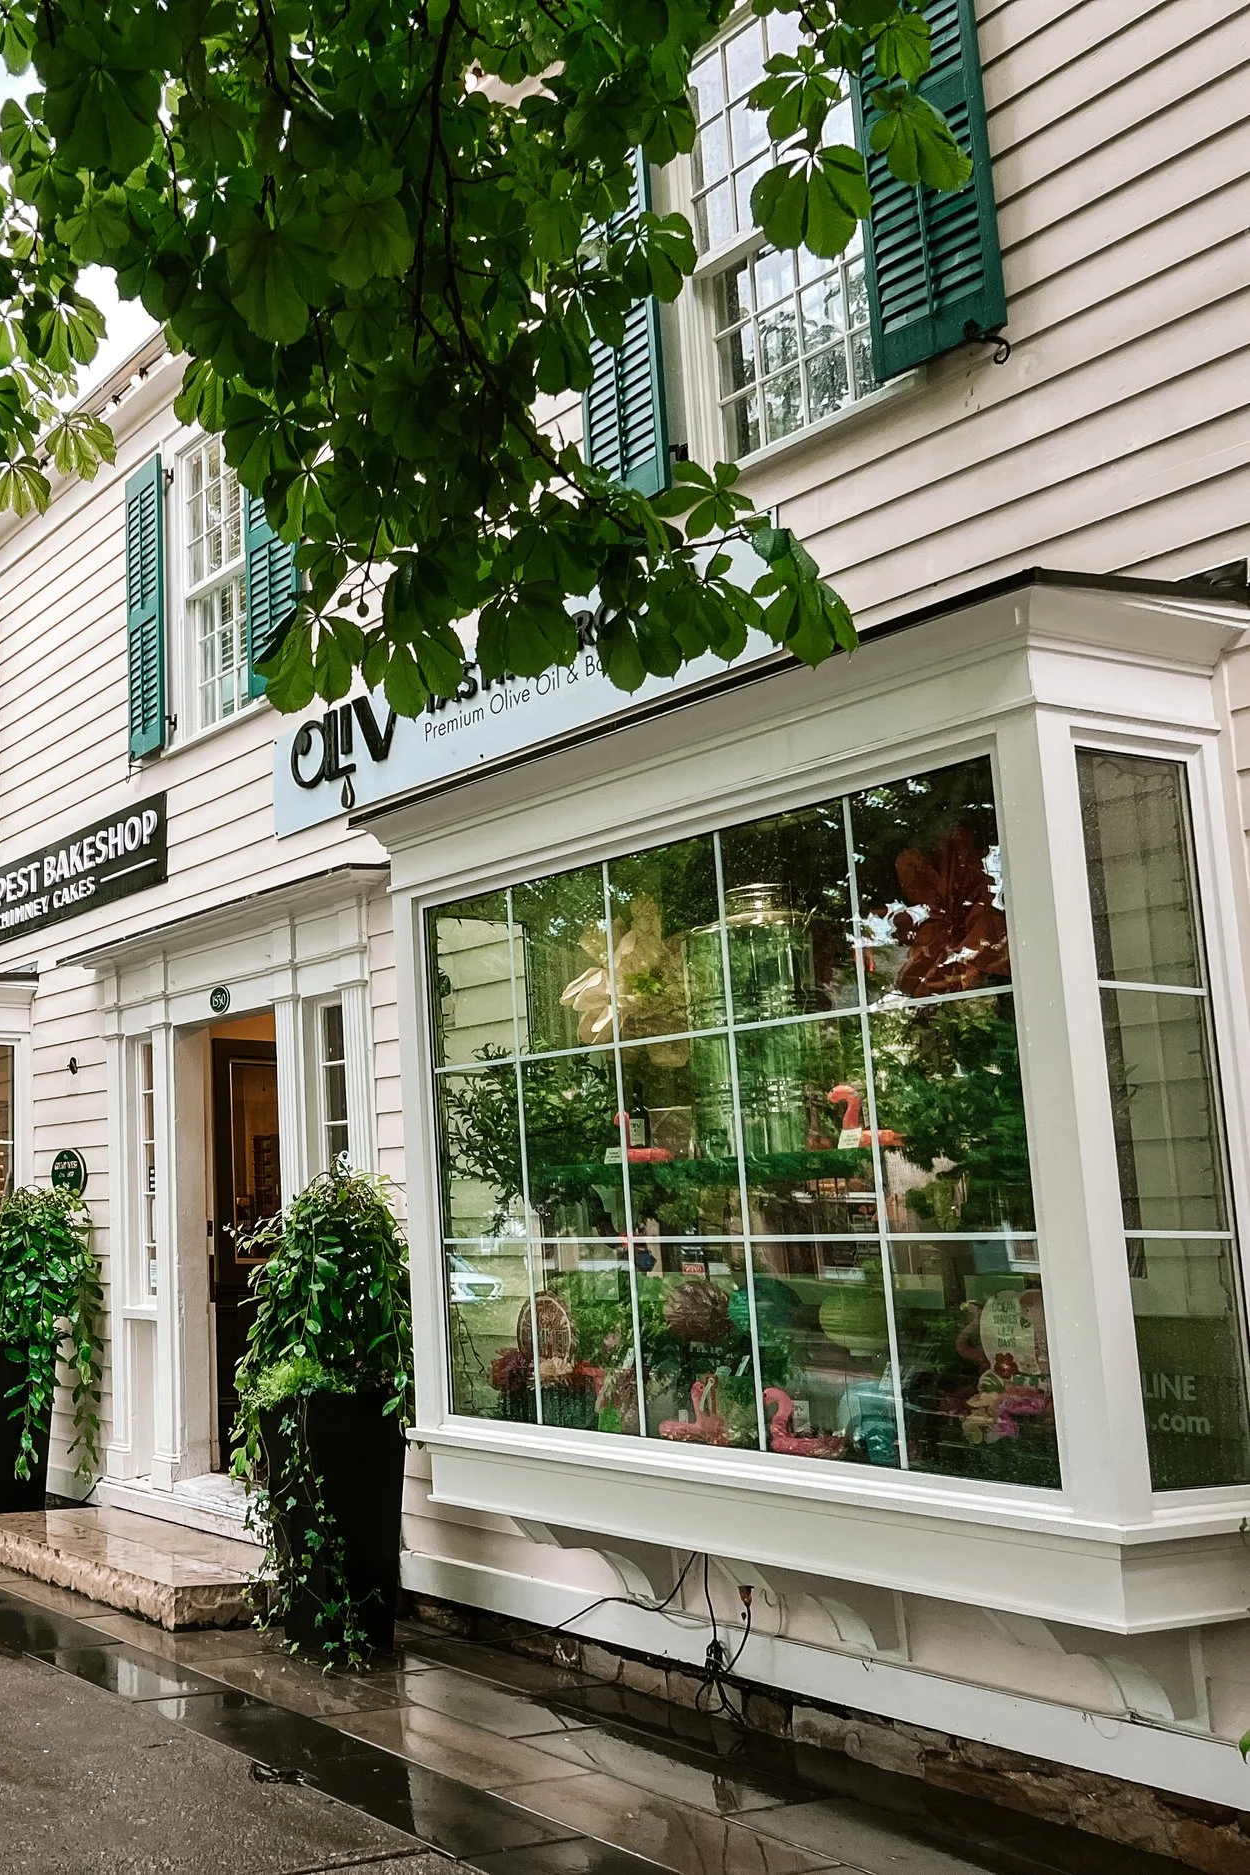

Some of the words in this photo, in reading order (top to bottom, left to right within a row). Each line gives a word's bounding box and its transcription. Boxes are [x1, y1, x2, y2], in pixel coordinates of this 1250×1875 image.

[424, 707, 485, 742] Premium
[489, 688, 531, 715] Olive
[536, 667, 560, 696] Oil
[566, 663, 579, 685] &
[43, 809, 158, 888] BAKESHOP
[52, 876, 96, 909] CAKES
[1147, 1411, 1211, 1435] .com
